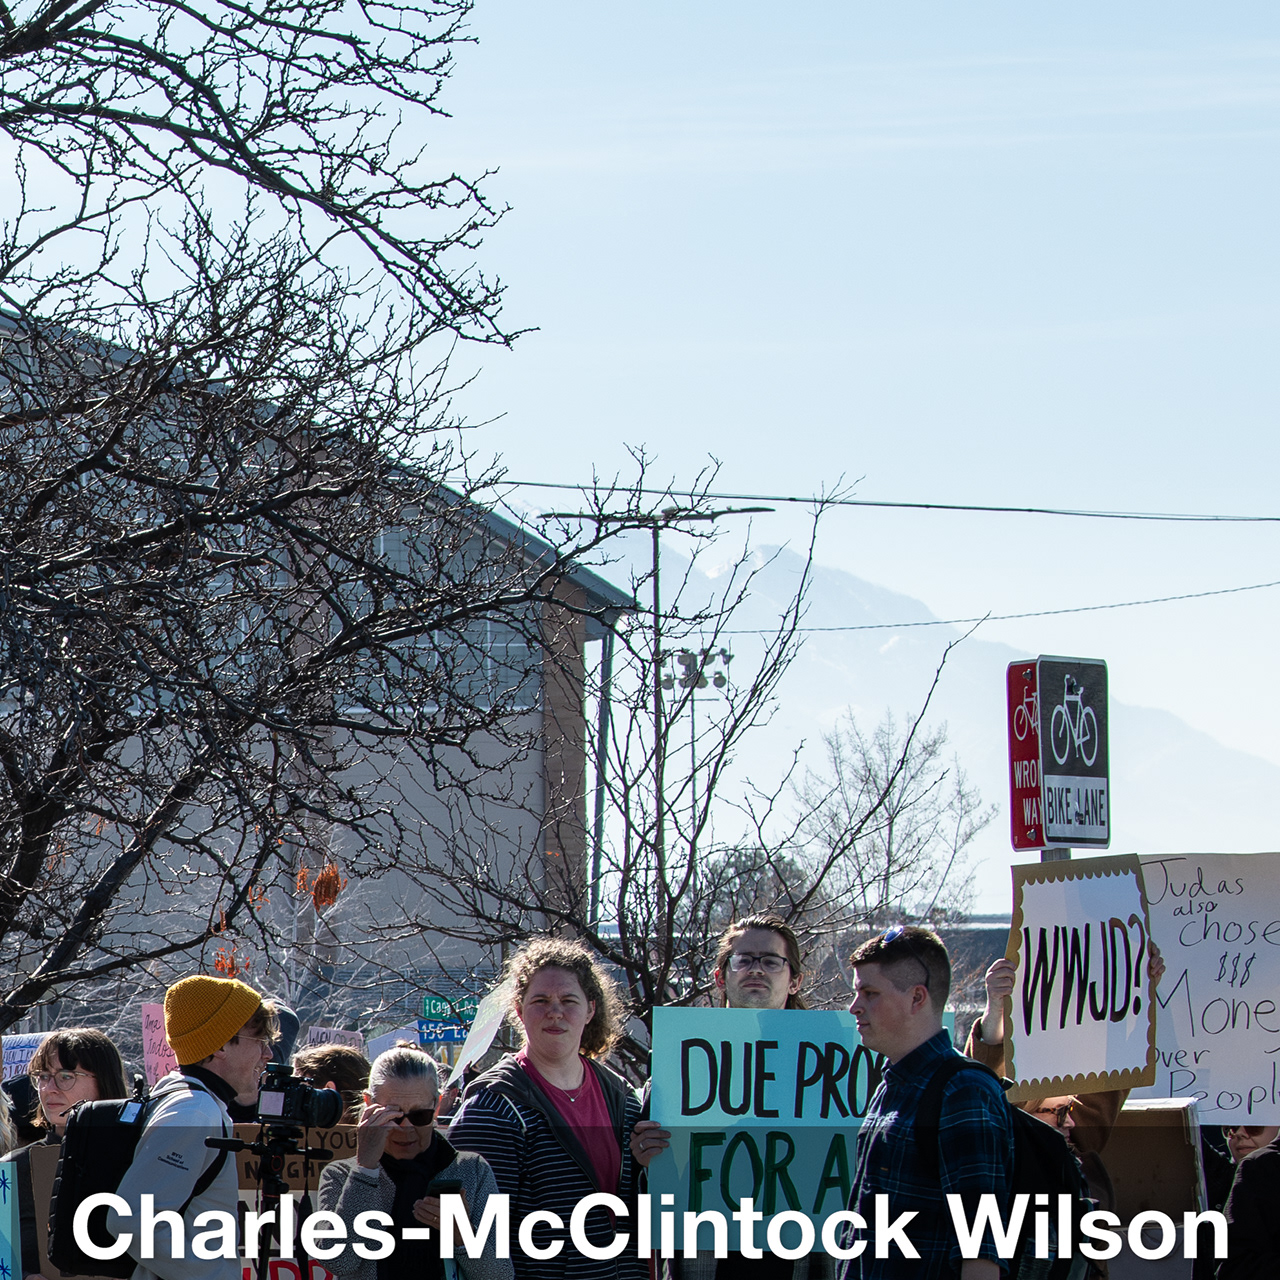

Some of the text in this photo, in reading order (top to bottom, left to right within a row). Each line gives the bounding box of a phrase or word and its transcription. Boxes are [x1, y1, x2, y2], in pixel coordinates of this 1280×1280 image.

[1014, 759, 1040, 789] WRO
[1047, 787, 1106, 826] BIKE LANE
[1140, 857, 1244, 905] Judas
[1173, 899, 1218, 917] also
[1023, 913, 1145, 1036] WWJD?
[1155, 968, 1280, 1038] Mone
[681, 1038, 886, 1119] DUE PRO
[1170, 1061, 1280, 1115] Peopl
[316, 1131, 357, 1150] YOU
[688, 1131, 802, 1217] FOR
